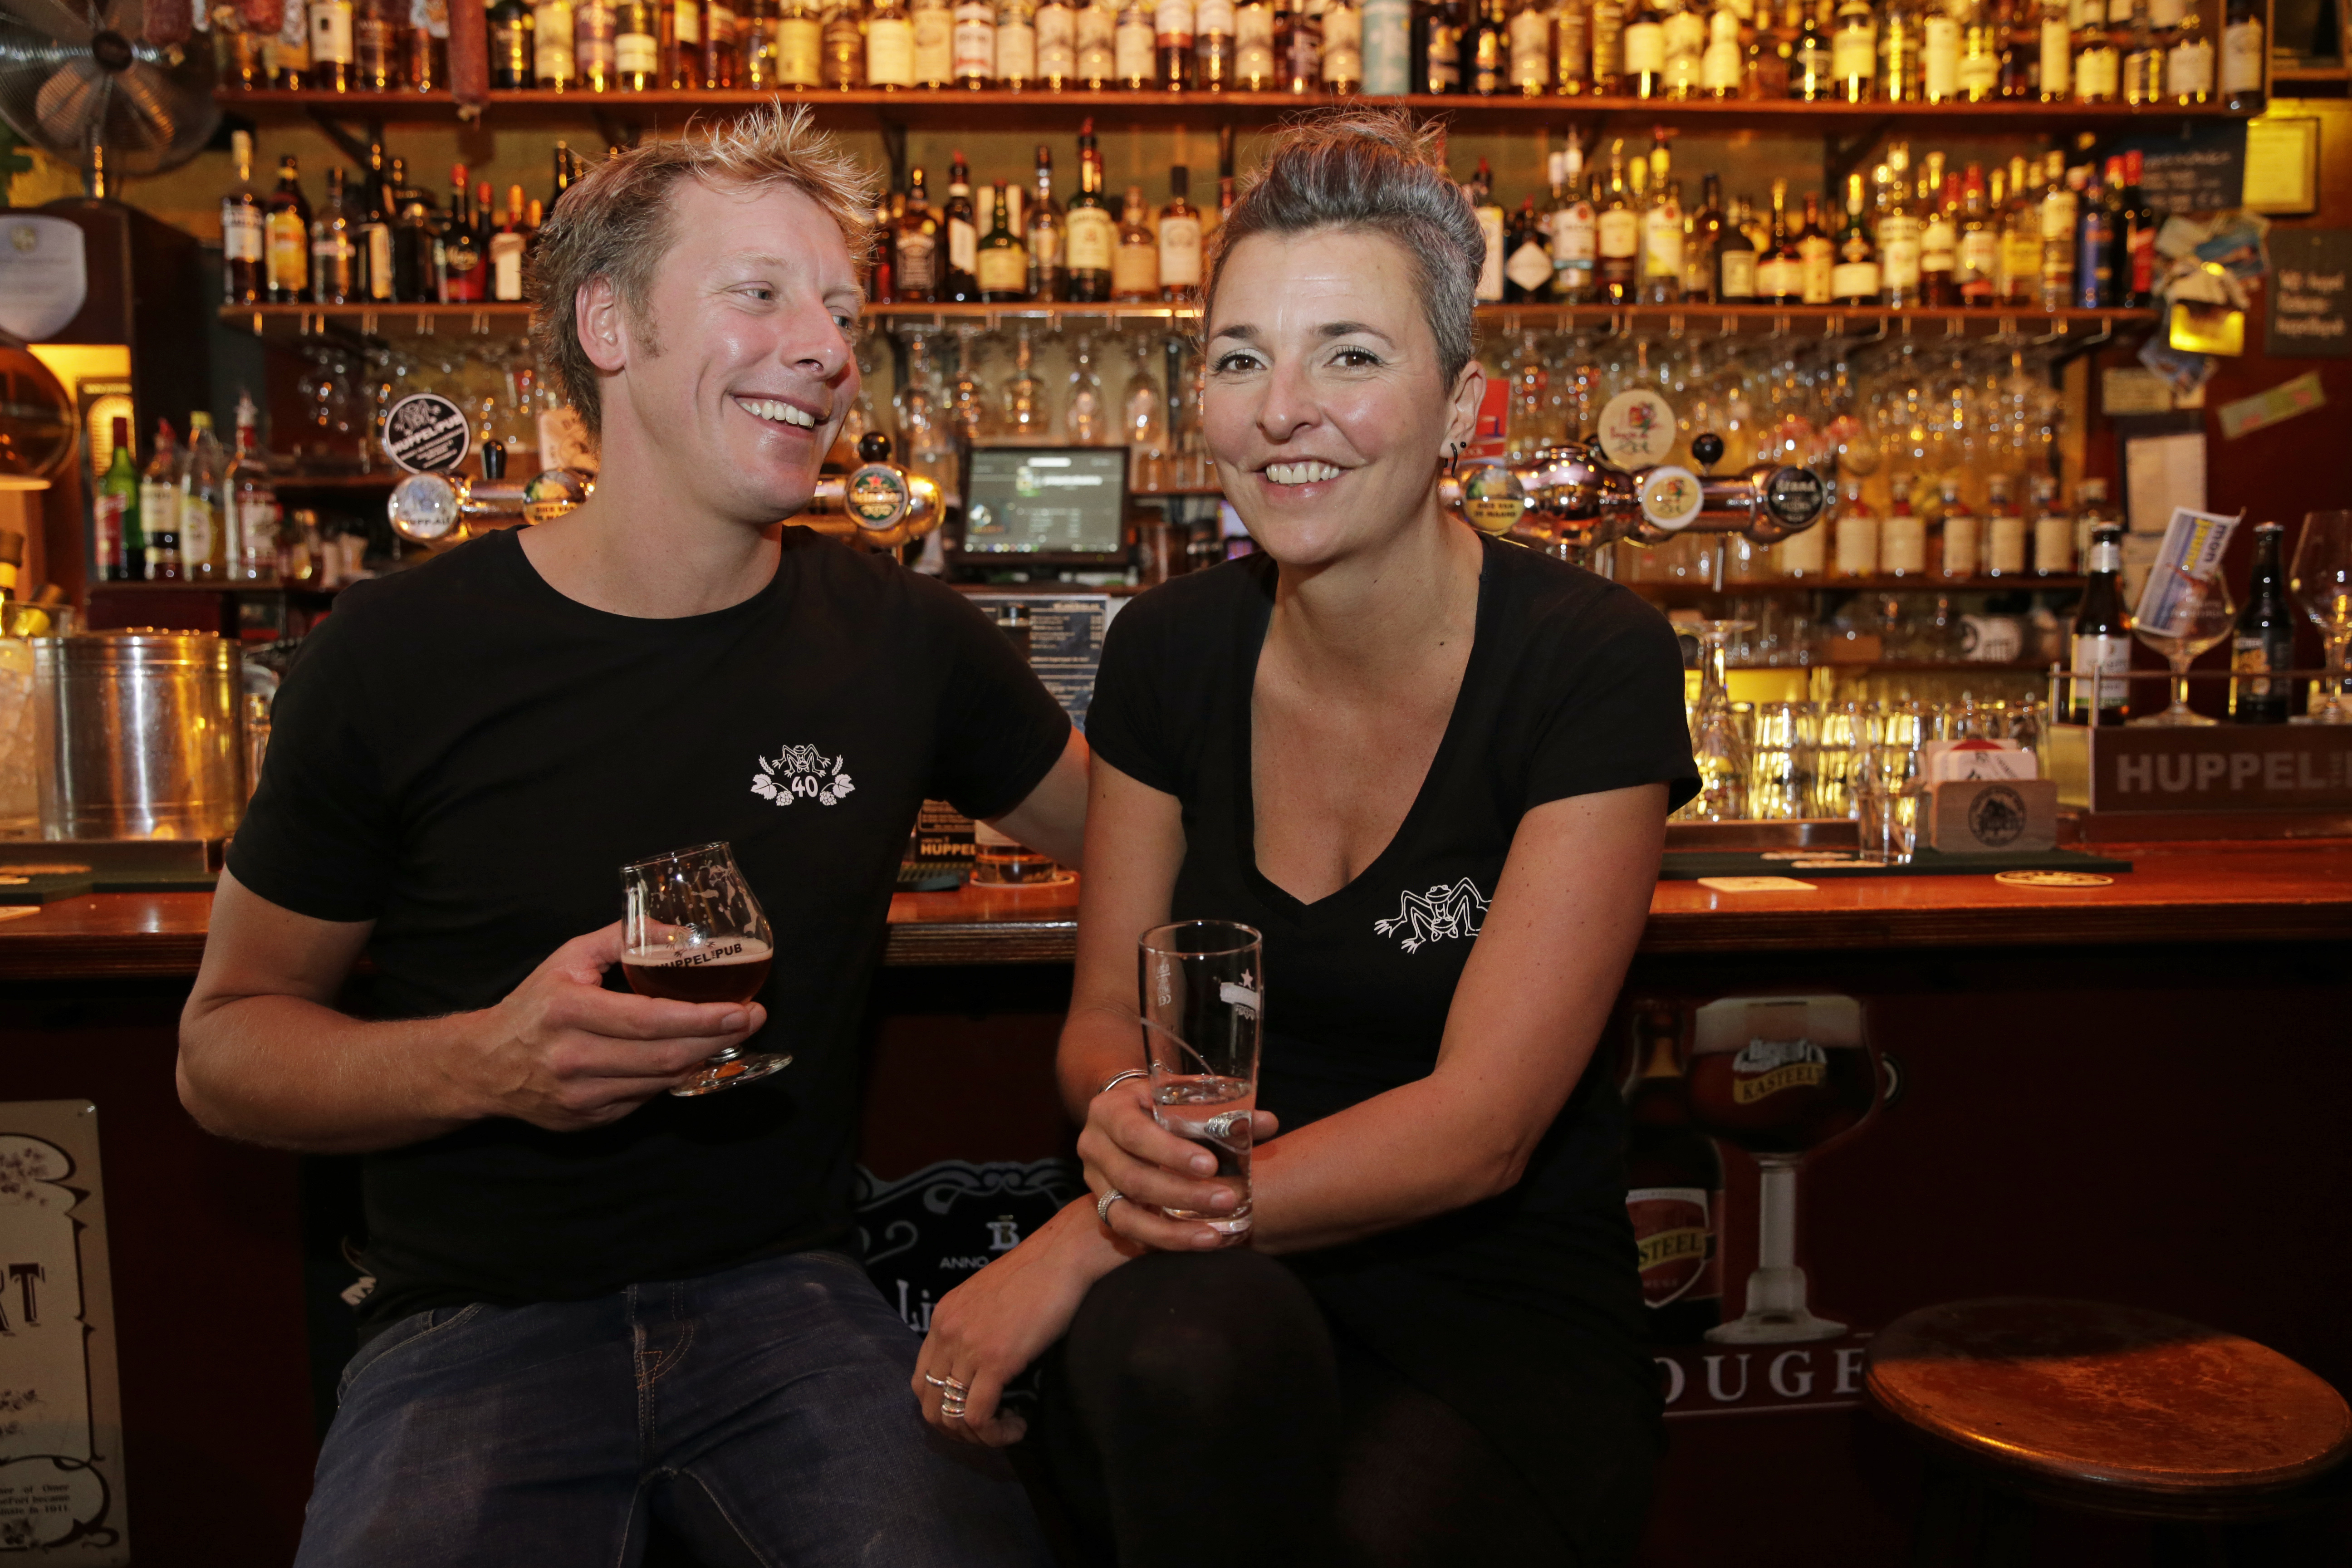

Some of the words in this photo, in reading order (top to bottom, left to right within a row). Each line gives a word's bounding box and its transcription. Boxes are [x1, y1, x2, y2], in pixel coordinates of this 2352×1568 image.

[2116, 750, 2327, 793] HUPPEL
[792, 775, 818, 797] 40
[715, 943, 742, 959] PUB
[939, 1256, 990, 1269] ANNO
